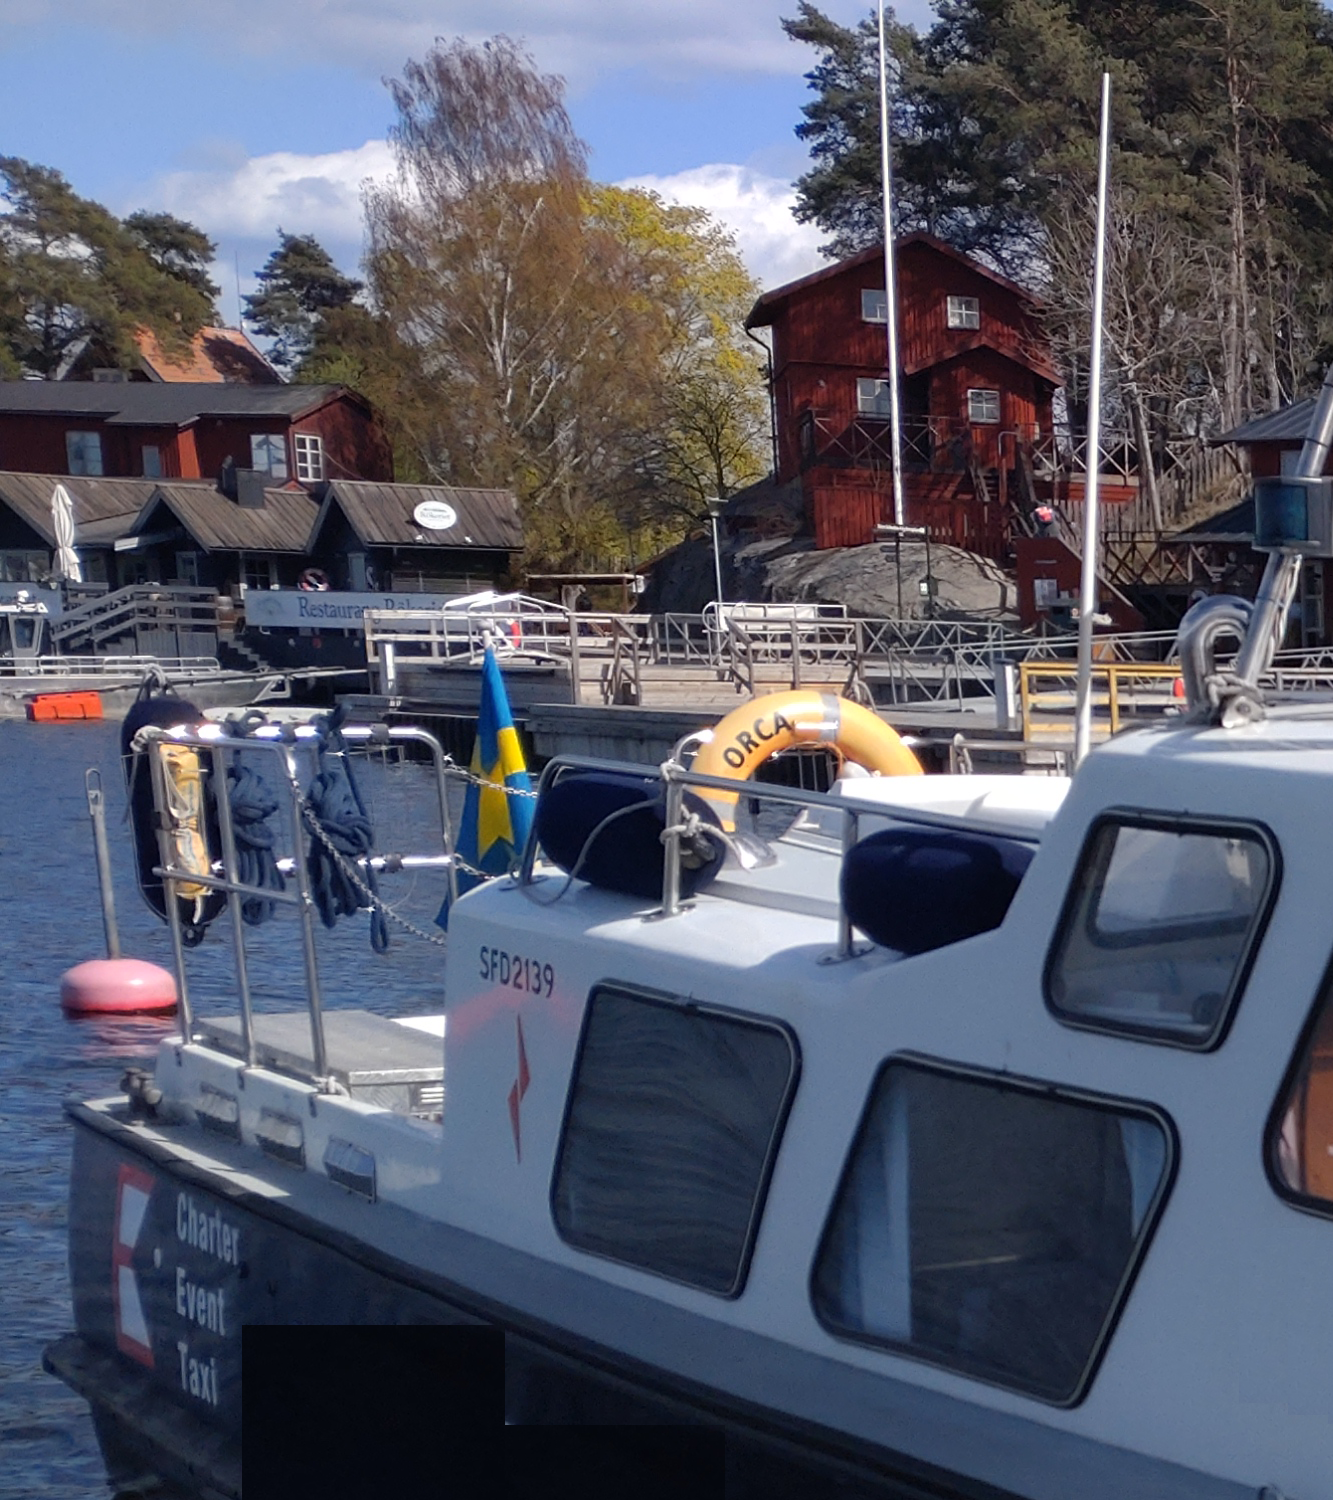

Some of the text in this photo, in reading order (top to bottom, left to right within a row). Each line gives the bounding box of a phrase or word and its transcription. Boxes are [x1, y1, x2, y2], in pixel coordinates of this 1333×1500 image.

[723, 711, 792, 769] ORCA
[480, 945, 554, 998] SFD2139
[176, 1192, 240, 1267] Charter
[176, 1267, 226, 1336] Event
[177, 1341, 218, 1406] Taxi
